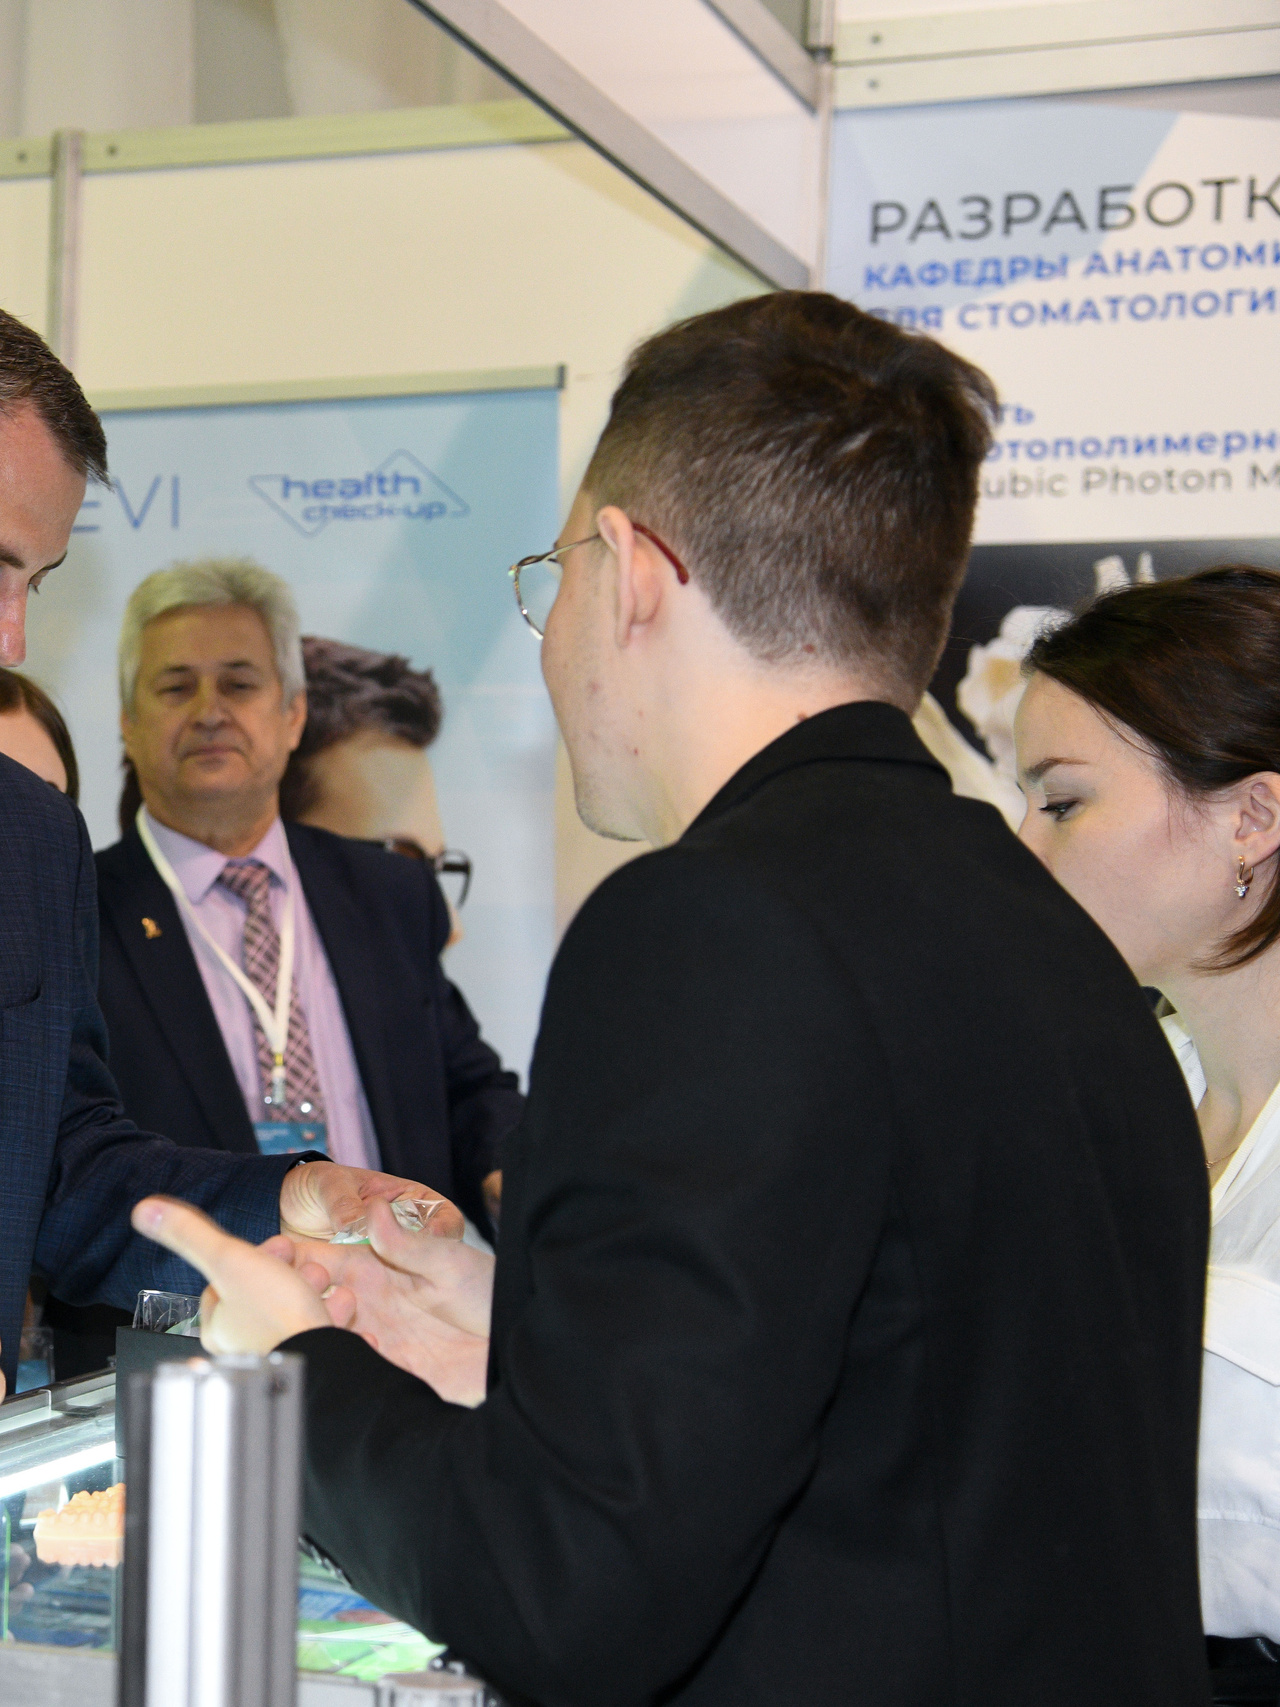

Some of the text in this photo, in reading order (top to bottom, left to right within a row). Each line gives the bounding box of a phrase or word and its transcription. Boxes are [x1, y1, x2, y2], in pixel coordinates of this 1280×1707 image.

[870, 175, 1280, 245] РАЗРАБОТК
[863, 253, 1069, 291] КАФЕДРЫ
[958, 287, 1276, 330] СТОМАТОЛОГИ
[283, 472, 421, 499] health
[1082, 466, 1233, 495] Photon
[302, 501, 447, 521] check-up
